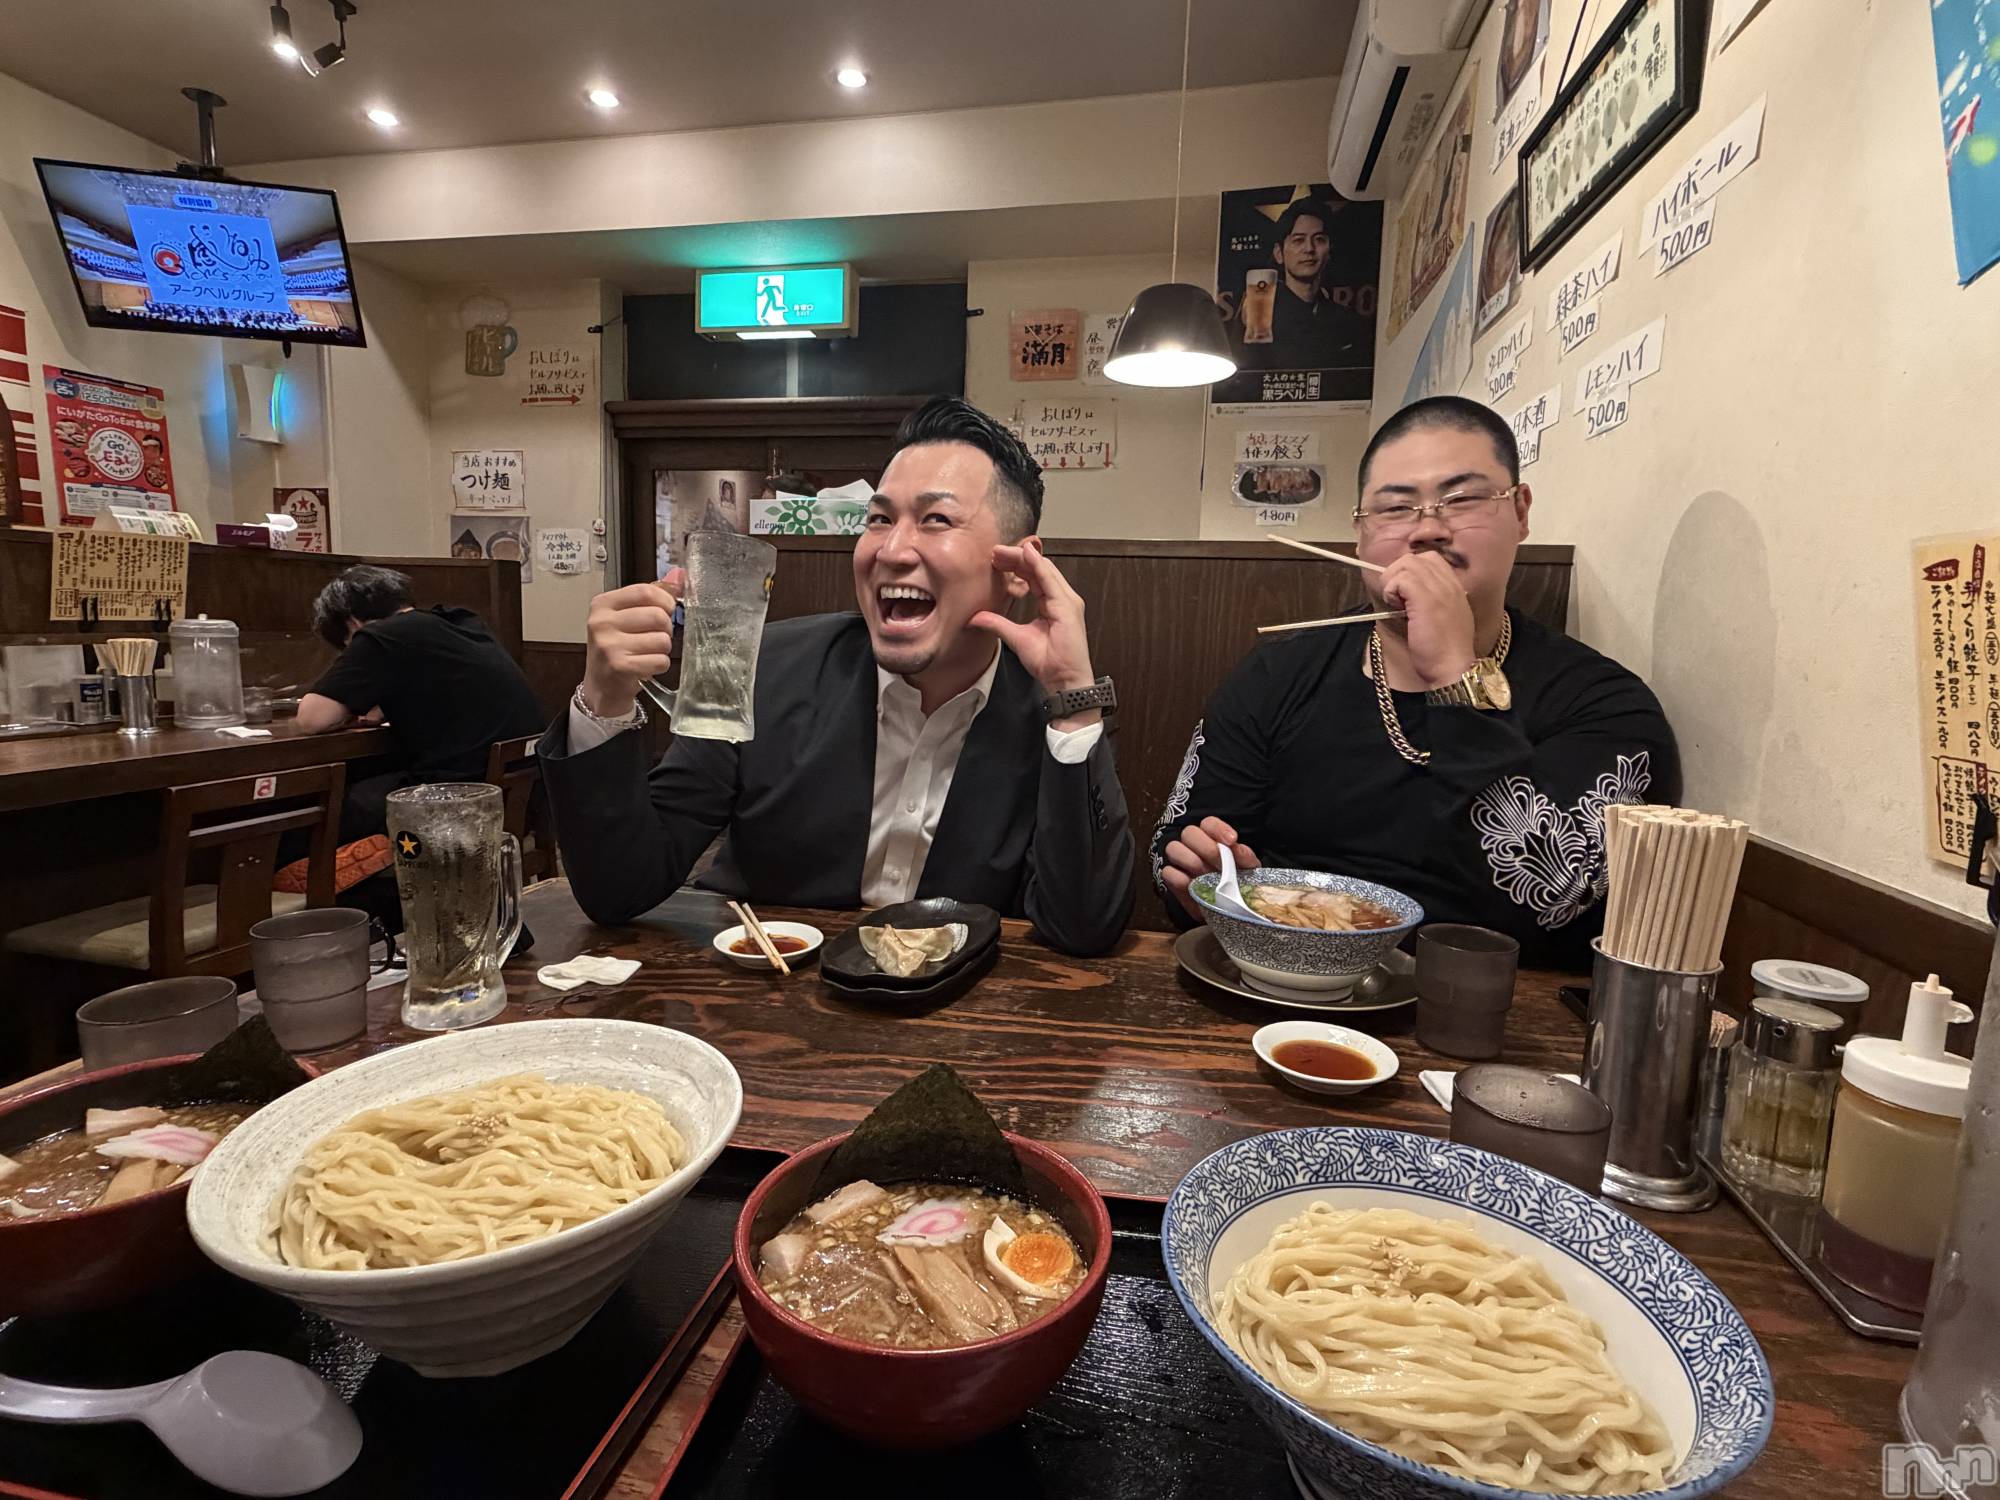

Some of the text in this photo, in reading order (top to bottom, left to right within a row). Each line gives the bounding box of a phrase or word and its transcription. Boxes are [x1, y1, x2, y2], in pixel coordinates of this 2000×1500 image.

[1652, 141, 1743, 237] ハイボール
[1659, 220, 1711, 270] 500円
[1555, 251, 1611, 324] 緑茶ハイ
[1562, 312, 1596, 352] 500円
[1022, 340, 1066, 366] 満月
[1585, 334, 1648, 399] レモンハイ
[1262, 389, 1306, 400] 黒ラベル
[1488, 371, 1513, 399] 500円
[1513, 395, 1546, 437] 日本酒
[1588, 399, 1627, 434] 500円
[1033, 441, 1104, 457] お願い致します
[460, 469, 512, 491] つけ麺
[1258, 509, 1296, 522] 480円
